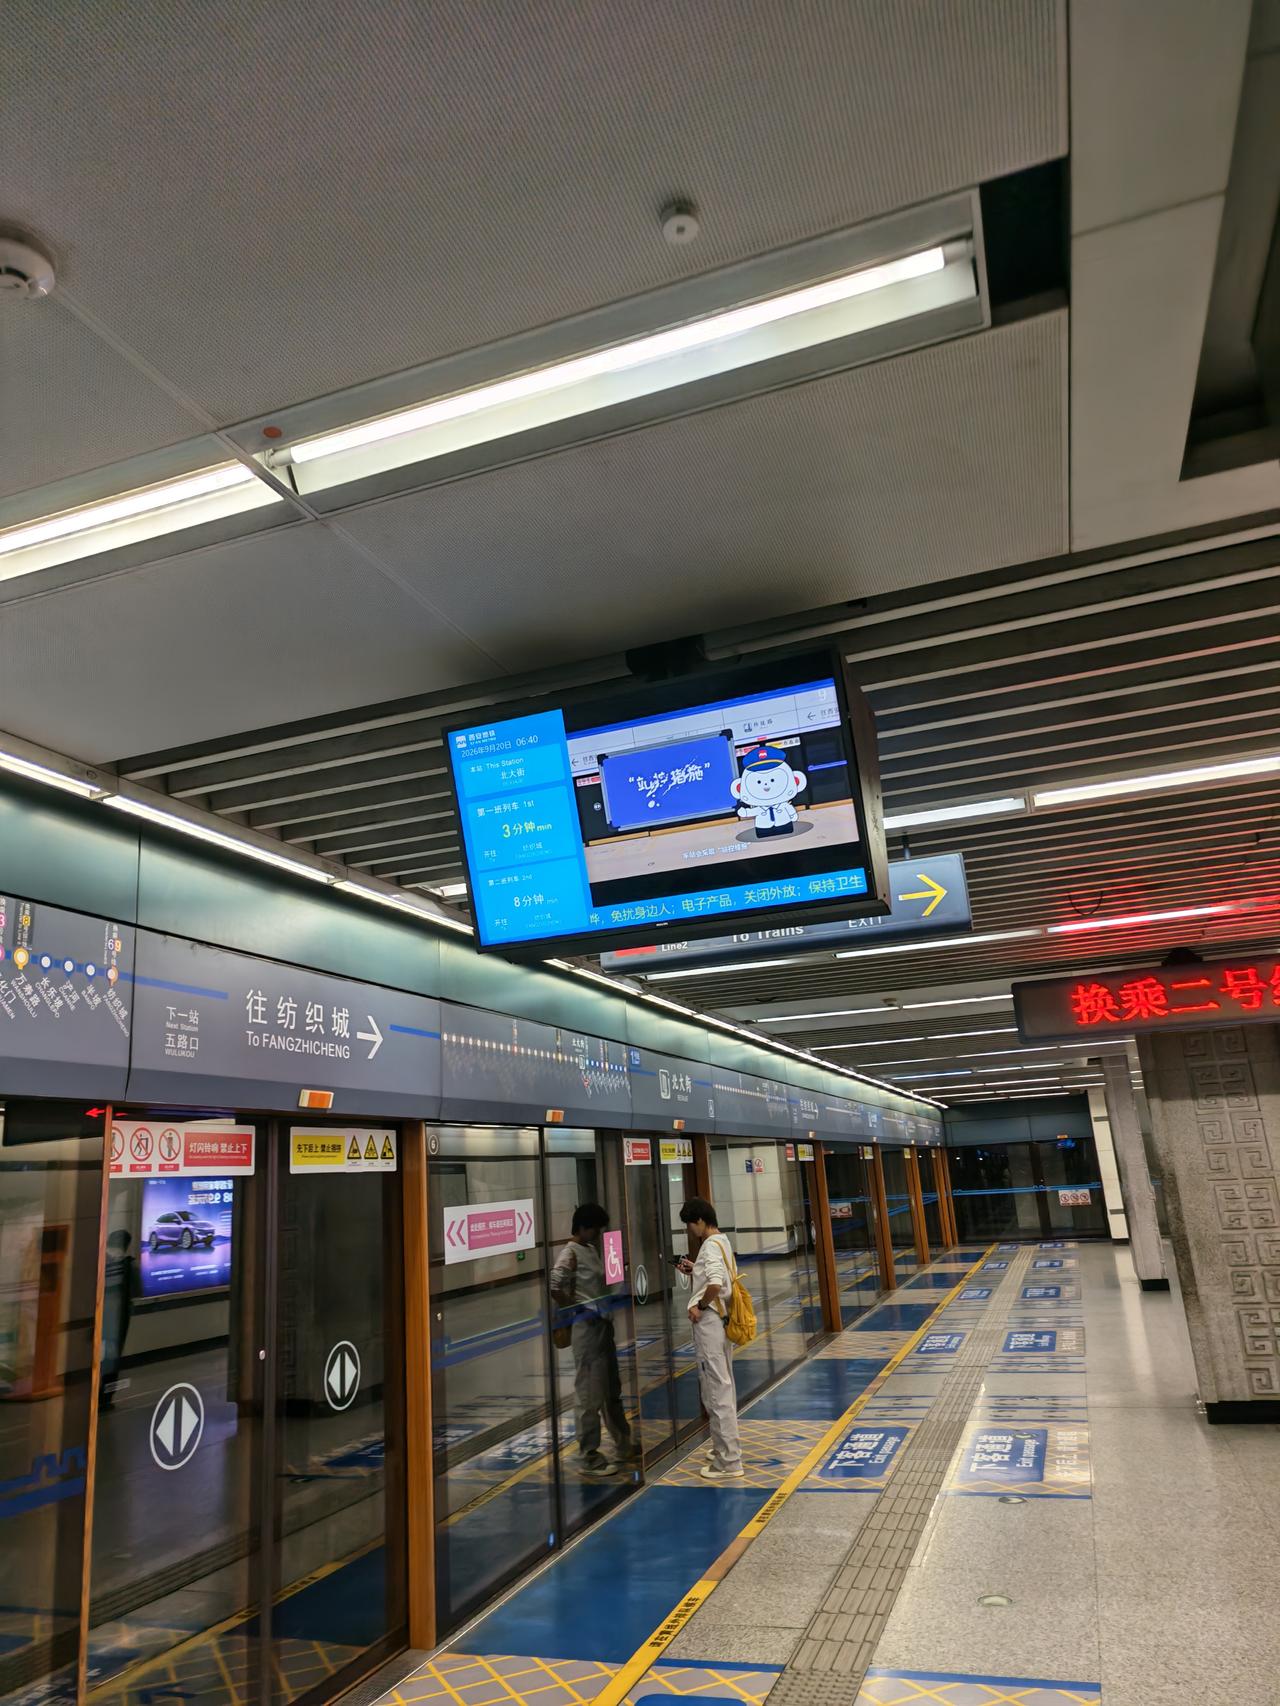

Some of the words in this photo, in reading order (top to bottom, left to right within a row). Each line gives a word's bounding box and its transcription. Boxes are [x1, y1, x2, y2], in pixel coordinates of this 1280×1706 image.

[461, 741, 512, 758] 2026年9月20日
[515, 734, 539, 747] 06:40
[501, 757, 524, 767] Station
[501, 768, 525, 780] 北大街
[476, 801, 520, 817] 第一班列车
[523, 799, 535, 808] 1st
[1071, 964, 1280, 1025] 换乘二号
[166, 1006, 200, 1026] 下一站
[246, 989, 350, 1039] 往纺织城
[165, 1033, 200, 1051] 五路口
[246, 1031, 260, 1047] To
[262, 1033, 351, 1060] FANGZHICHENG
[828, 1433, 884, 1470] 下客通道
[970, 1435, 1015, 1473] 下客通道
